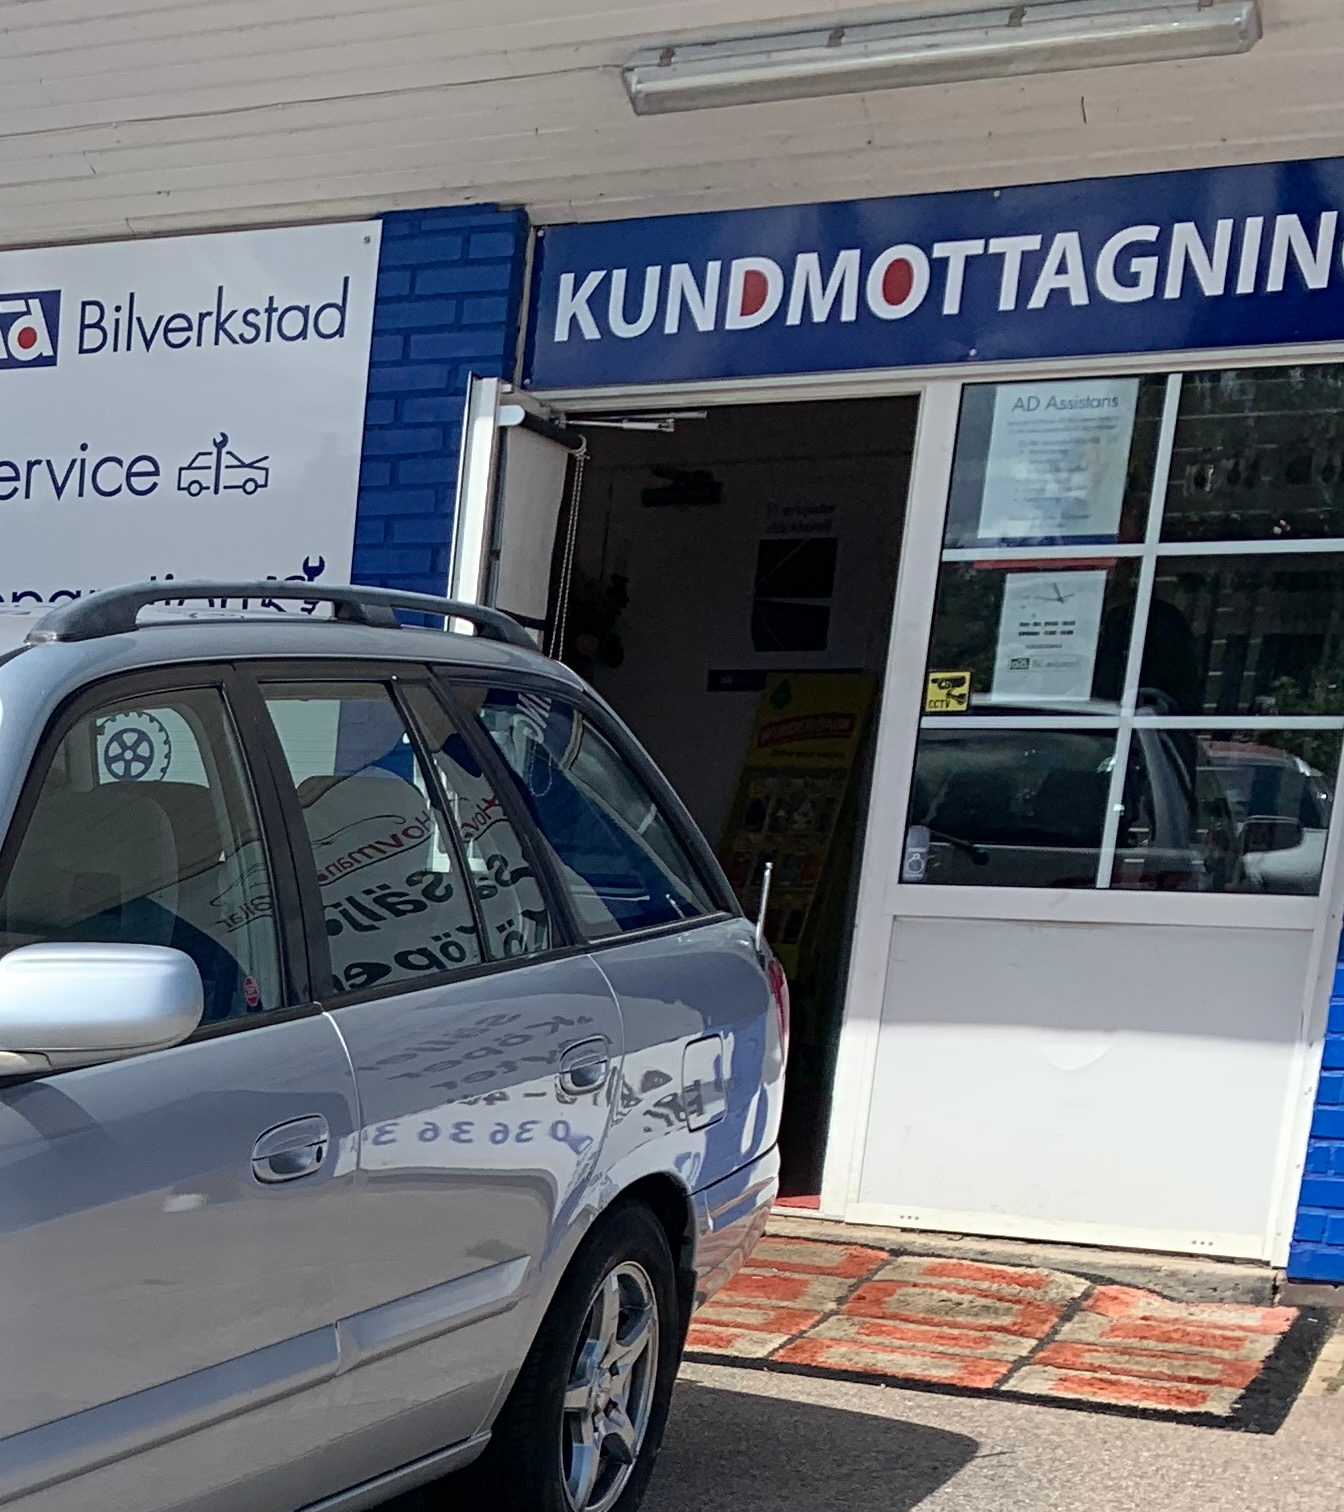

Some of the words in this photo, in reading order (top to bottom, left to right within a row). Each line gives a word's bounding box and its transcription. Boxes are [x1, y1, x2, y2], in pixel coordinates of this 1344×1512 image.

[553, 209, 1344, 344] KUNDMOTTAGNIN
[77, 275, 351, 355] Bilverkstad
[1012, 395, 1041, 412] AD
[1044, 394, 1120, 411] Assistans
[928, 698, 951, 709] CCTV
